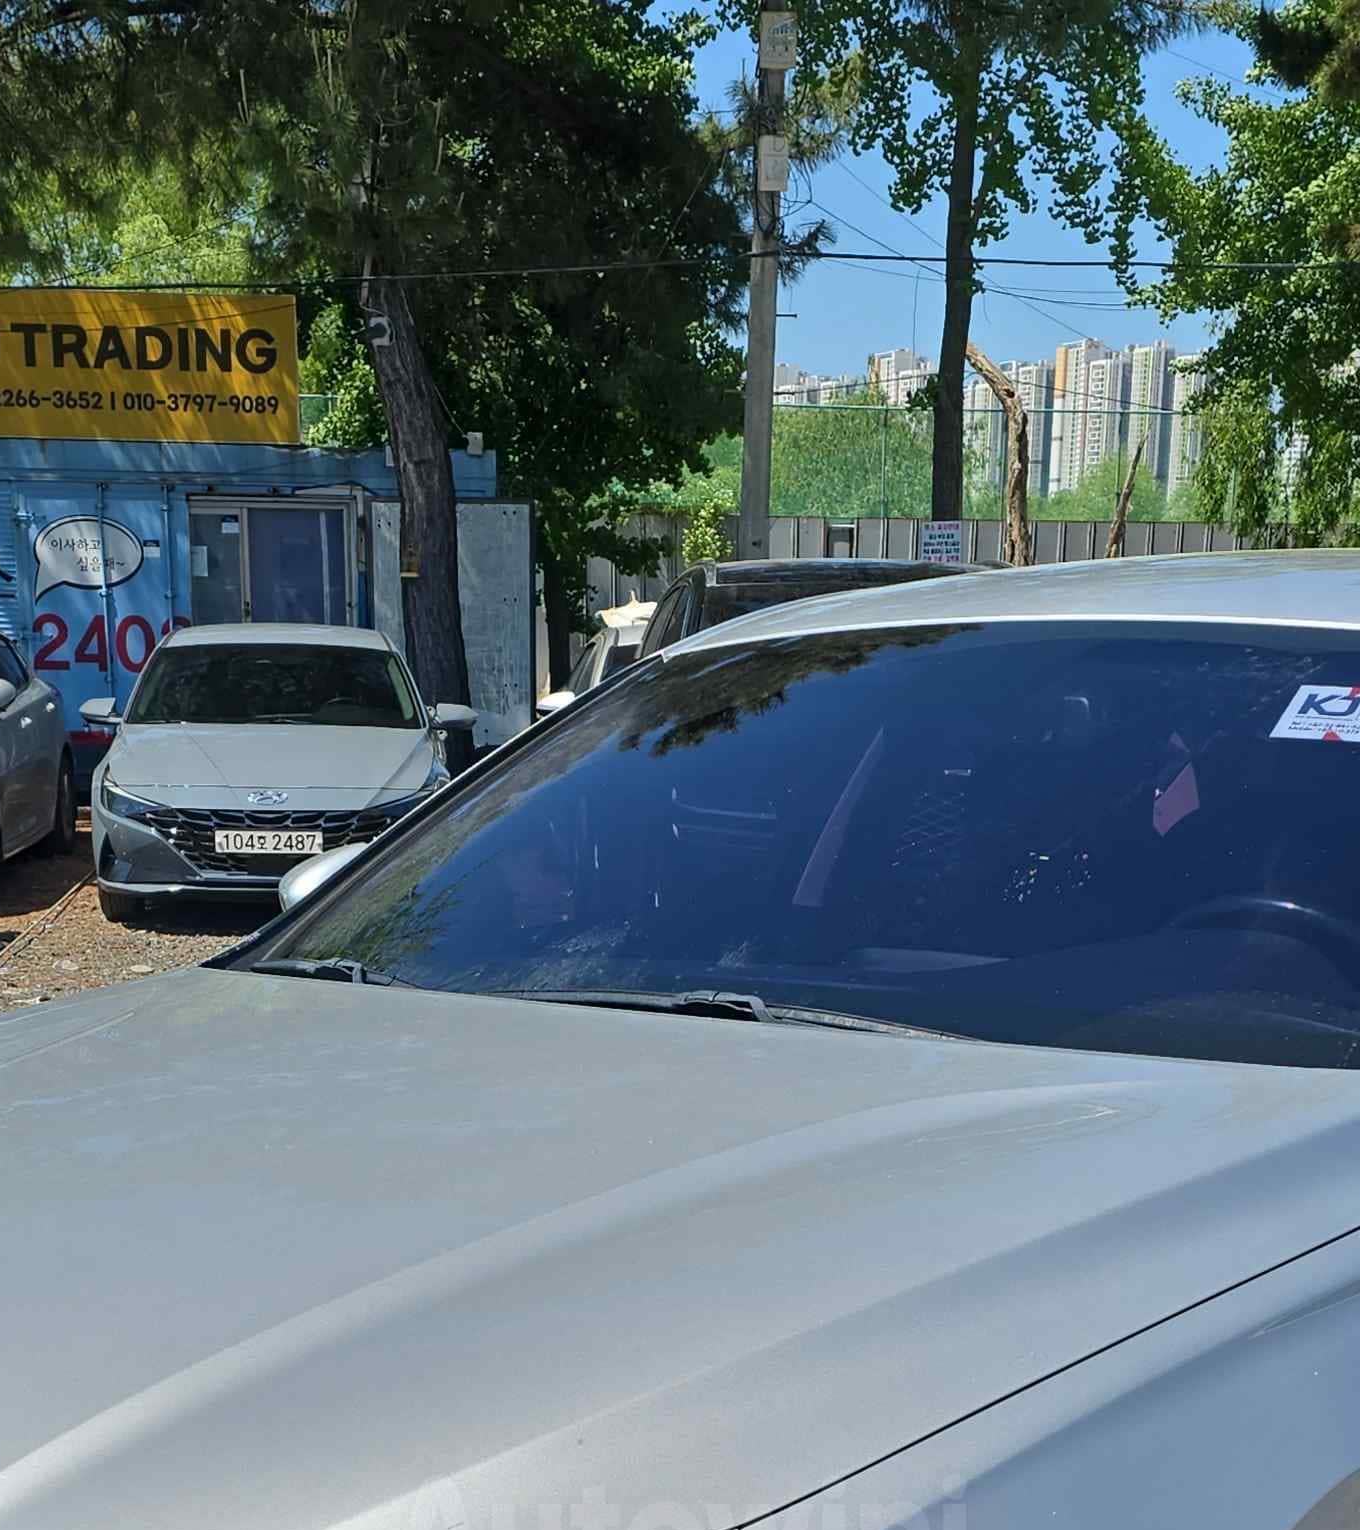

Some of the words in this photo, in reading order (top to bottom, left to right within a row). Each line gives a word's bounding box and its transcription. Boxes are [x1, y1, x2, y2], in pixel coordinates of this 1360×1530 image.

[9, 322, 278, 374] TRADING
[122, 391, 280, 416] 010-3797-9089
[271, 833, 317, 851] 2487
